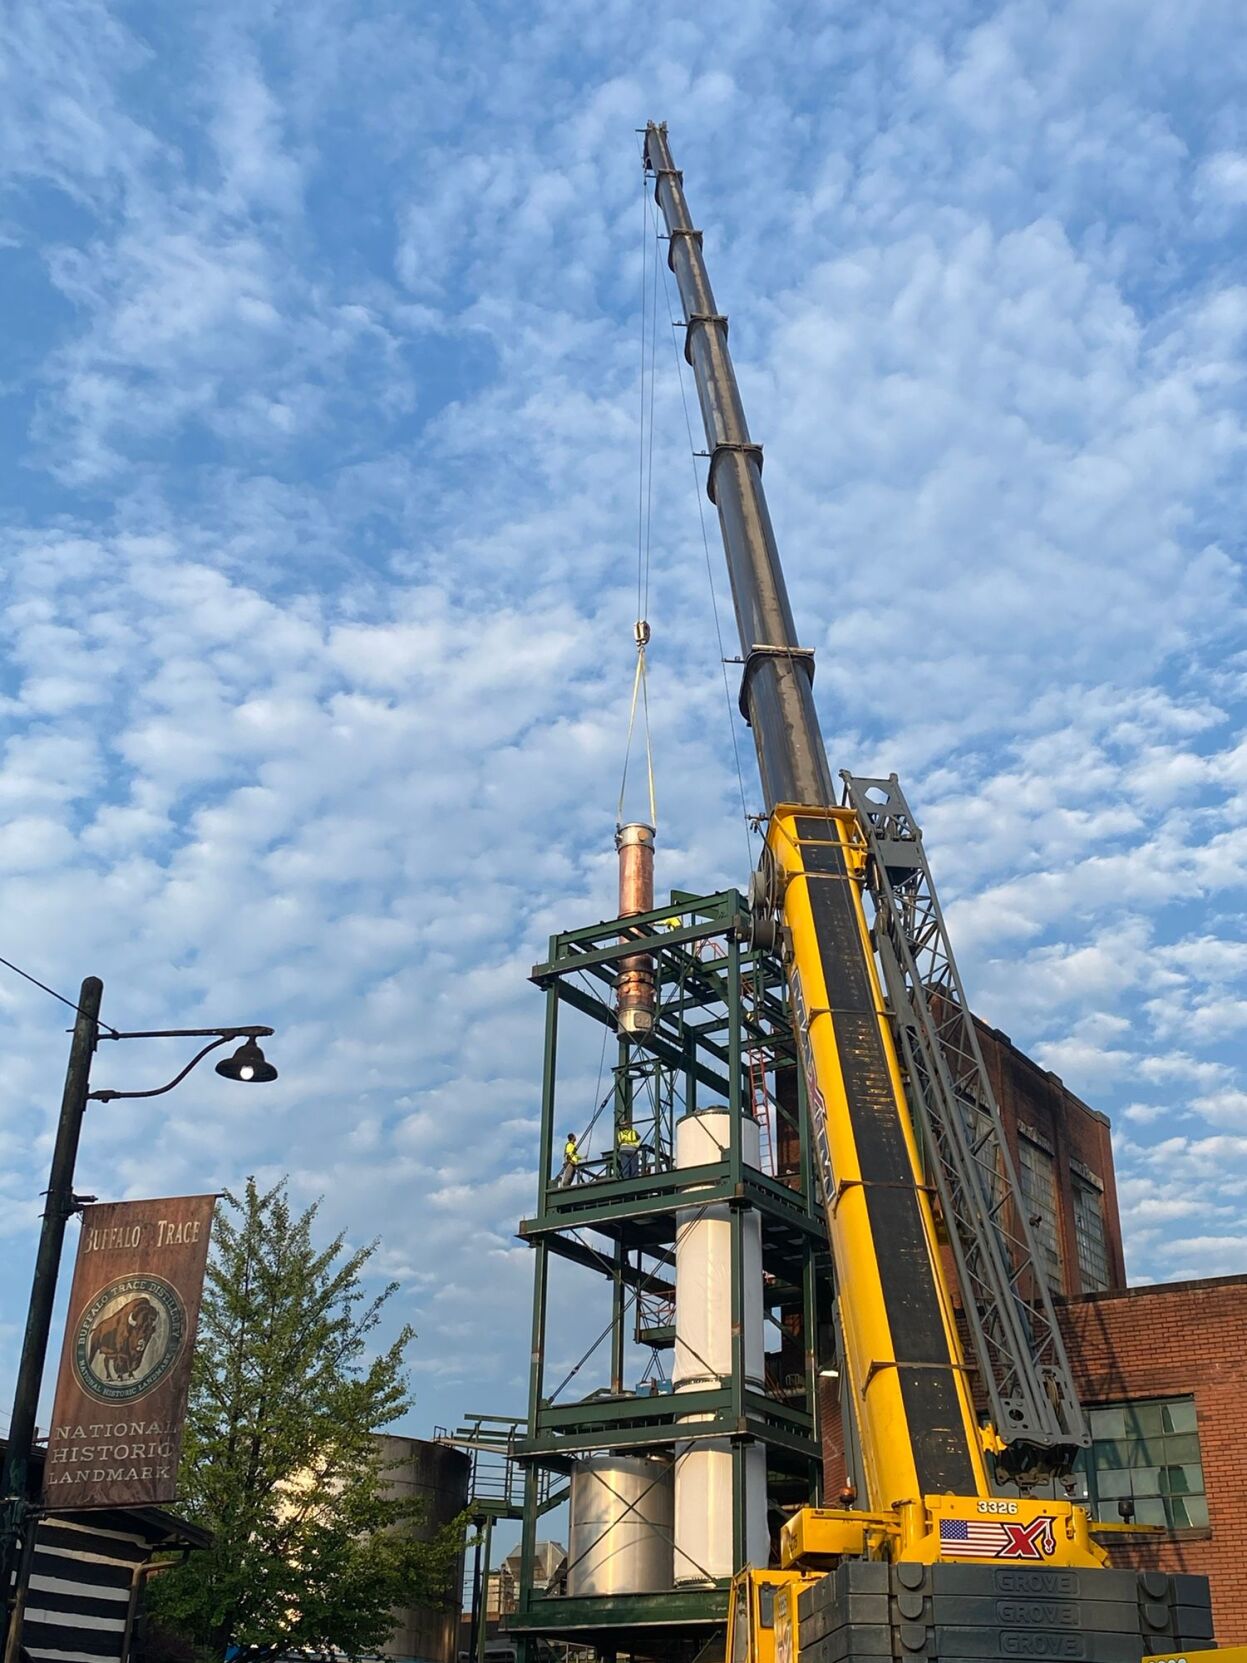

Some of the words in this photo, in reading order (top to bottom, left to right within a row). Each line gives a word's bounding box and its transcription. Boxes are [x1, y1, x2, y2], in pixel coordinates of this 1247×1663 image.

[157, 1220, 200, 1248] TRACE
[78, 1294, 109, 1345] BUFFALO
[111, 1280, 147, 1297] TRACE
[148, 1281, 180, 1338] DISTILLERY
[78, 1360, 103, 1392] NATIONAL
[102, 1388, 137, 1400] HISTORIC
[138, 1354, 173, 1391] LANDMARK
[56, 1422, 176, 1440] NATIONAL
[51, 1445, 173, 1463] HISTORIC
[48, 1467, 170, 1484] LANDMARK
[978, 1501, 1018, 1514] 3326
[1000, 1576, 1071, 1592] GROVE
[1001, 1607, 1073, 1624] GROVE
[1003, 1637, 1078, 1655] GROVE
